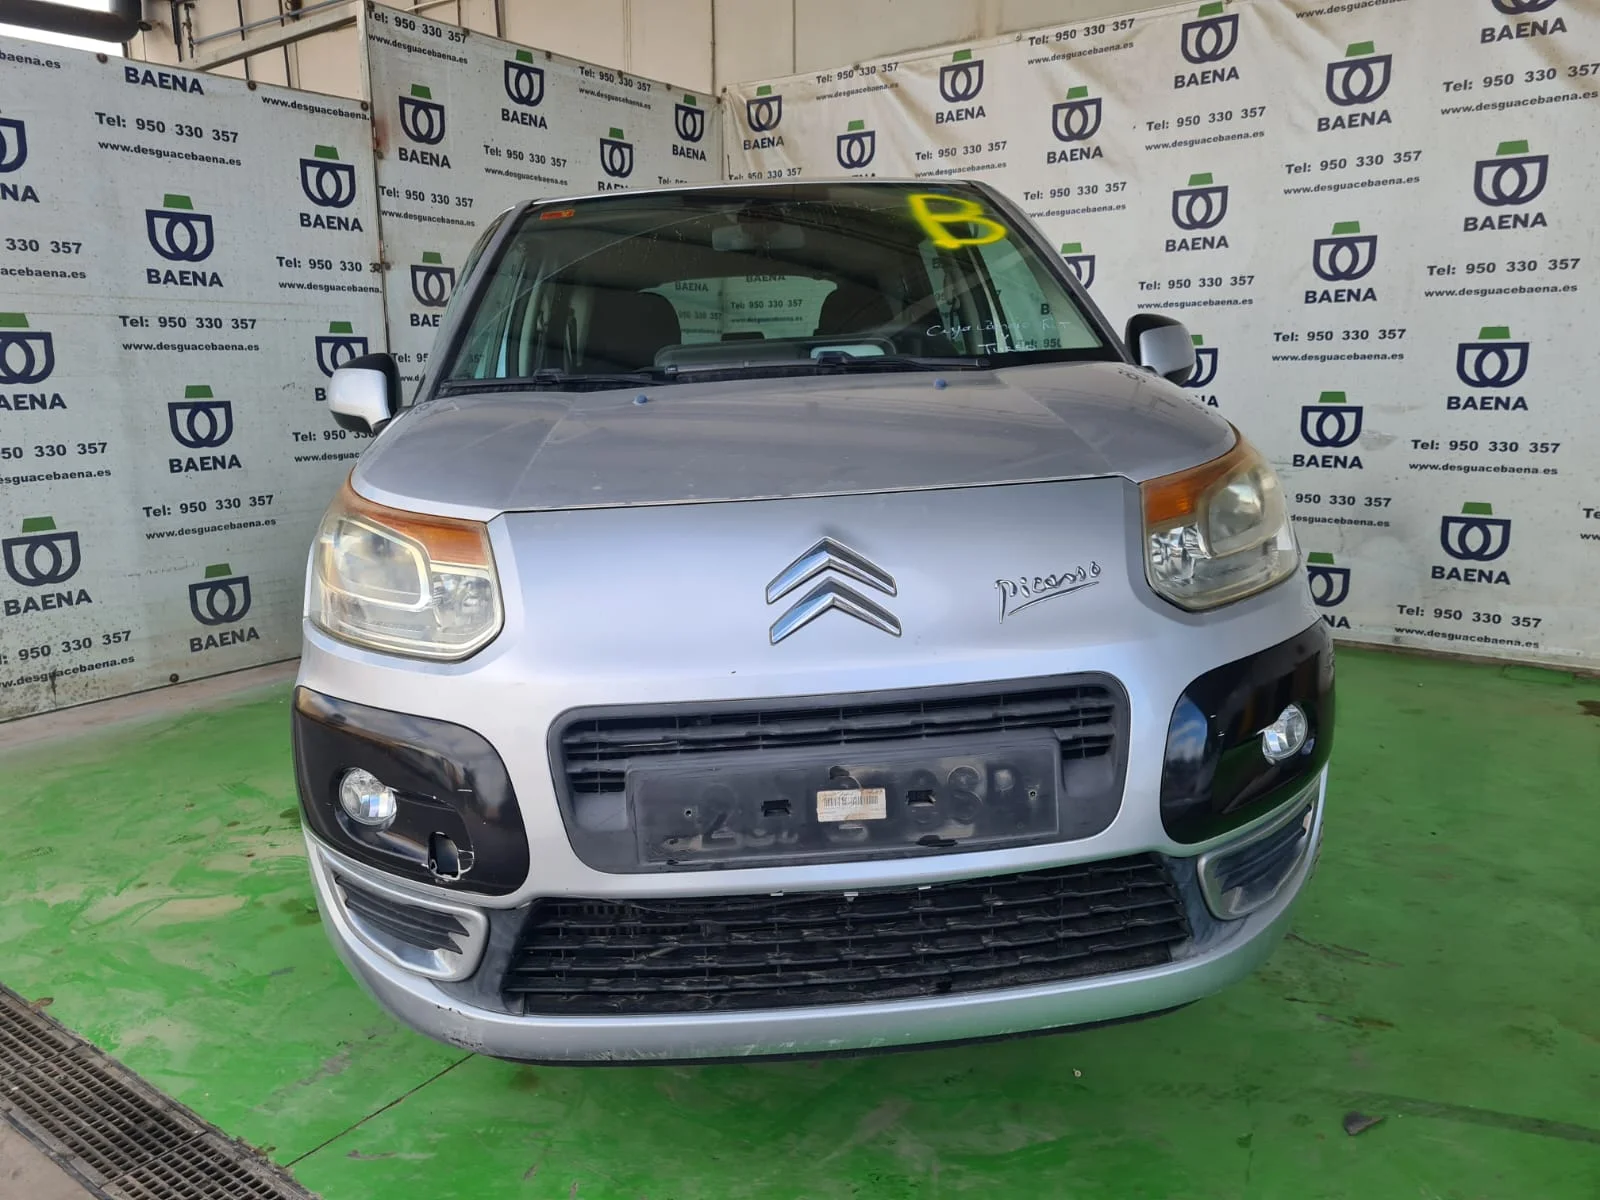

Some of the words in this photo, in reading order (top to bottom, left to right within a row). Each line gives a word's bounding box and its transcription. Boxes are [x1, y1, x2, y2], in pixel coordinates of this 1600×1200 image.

[366, 10, 388, 24] Tel:
[394, 16, 415, 31] 950
[422, 24, 441, 37] 330
[448, 30, 467, 44] 357
[1028, 35, 1049, 46] Tel:
[1055, 29, 1076, 42] 950
[1084, 24, 1105, 36] 330
[1112, 18, 1135, 31] 357
[1481, 18, 1567, 44] BAENA
[368, 33, 468, 65] www.desguacebaena.es
[1028, 42, 1133, 64] www.desguacebaena.es
[124, 66, 204, 95] BAENA
[578, 66, 595, 78] Tel:
[599, 71, 614, 83] 950
[619, 76, 633, 88] 330
[637, 81, 651, 92] 357
[816, 74, 832, 84] Tel:
[837, 70, 854, 81] 950
[859, 66, 877, 77] 330
[881, 62, 899, 73] 357
[1174, 67, 1239, 89] BAENA
[1443, 80, 1472, 92] Tel:
[1483, 74, 1514, 88] 950
[1525, 68, 1557, 82] 330
[1568, 63, 1600, 77] 357
[579, 88, 651, 110] www.desguacebaena.es
[816, 82, 899, 101] www.desguacebaena.es
[1441, 91, 1598, 115] www.desguacebaena.es
[502, 108, 547, 129] BAENA
[936, 106, 986, 124] BAENA
[1146, 120, 1168, 131] Tel:
[1177, 115, 1200, 127] 950
[1209, 111, 1232, 123] 330
[1241, 106, 1266, 118] 357
[1318, 110, 1392, 132] BAENA
[95, 112, 126, 128] Tel:
[136, 118, 165, 133] 950
[175, 124, 203, 138] 330
[212, 129, 238, 143] 357
[744, 136, 784, 150] BAENA
[1145, 131, 1264, 150] www.desguacebaena.es
[98, 142, 241, 166] www.desguacebaena.es
[399, 147, 451, 168] BAENA
[484, 145, 501, 156] Tel:
[507, 149, 524, 160] 950
[529, 153, 546, 164] 330
[551, 157, 567, 167] 357
[673, 144, 706, 161] BAENA
[915, 151, 932, 160] Tel:
[938, 148, 956, 157] 950
[963, 144, 981, 155] 330
[988, 141, 1007, 151] 357
[1047, 146, 1103, 164] BAENA
[787, 167, 802, 176] 357
[915, 162, 1007, 178] www.desguacebaena.es
[1285, 163, 1311, 174] Tel:
[1320, 159, 1346, 171] 950
[1356, 155, 1384, 167] 330
[1393, 150, 1422, 163] 357
[484, 168, 568, 185] www.desguacebaena.es
[1284, 177, 1420, 194] www.desguacebaena.es
[379, 186, 400, 198] Tel:
[405, 190, 424, 201] 950
[431, 193, 449, 205] 330
[456, 197, 473, 208] 357
[1024, 191, 1043, 200] Tel:
[1050, 188, 1070, 198] 950
[1078, 185, 1098, 195] 330
[1105, 182, 1126, 192] 357
[300, 213, 363, 232] BAENA
[381, 208, 475, 228] www.desguacebaena.es
[1464, 212, 1547, 232] BAENA
[6, 238, 39, 252] 330
[50, 241, 82, 254] 357
[1166, 236, 1228, 252] BAENA
[276, 256, 301, 268] Tel:
[309, 259, 332, 270] 950
[340, 261, 362, 272] 330
[1427, 265, 1456, 276] Tel:
[1466, 263, 1496, 274] 950
[1506, 260, 1537, 272] 330
[1548, 258, 1580, 270] 357
[147, 268, 223, 287] BAENA
[1139, 281, 1160, 290] Tel:
[1168, 279, 1191, 289] 950
[1199, 277, 1222, 287] 330
[1230, 276, 1254, 286] 357
[1305, 288, 1377, 304] BAENA
[1425, 285, 1577, 297] www.desguacebaena.es
[1138, 299, 1253, 309] www.desguacebaena.es
[119, 315, 149, 327] Tel:
[158, 317, 186, 328] 950
[196, 317, 222, 328] 330
[231, 319, 256, 329] 357
[410, 314, 440, 327] BAE
[1274, 332, 1298, 342] Tel:
[1307, 331, 1333, 341] 950
[1342, 330, 1369, 340] 330
[1378, 329, 1406, 339] 357
[122, 342, 259, 352] www.desguacebaena.es
[1272, 353, 1404, 362] www.desguacebaena.es
[1447, 396, 1528, 410] BAENA
[292, 432, 316, 442] Tel:
[324, 430, 346, 440] 950
[34, 444, 66, 457] 330
[77, 442, 107, 455] 357
[1411, 440, 1439, 450] Tel:
[1449, 441, 1478, 451] 950
[1488, 441, 1518, 452] 330
[1529, 443, 1560, 453] 357
[169, 455, 242, 473] BAENA
[1293, 455, 1363, 469] BAENA
[1409, 463, 1558, 475] www.desguacebaena.es
[142, 505, 171, 517] Tel:
[180, 501, 206, 513] 950
[216, 498, 241, 510] 330
[249, 495, 273, 507] 357
[1296, 494, 1321, 504] 950
[1329, 495, 1355, 505] 330
[1364, 497, 1391, 507] 357
[146, 519, 276, 539] www.desguacebaena.es
[1431, 566, 1510, 585] BAENA
[4, 589, 92, 616] BAENA
[1397, 605, 1424, 616] Tel:
[1434, 608, 1462, 620] 950
[1472, 612, 1501, 624] 330
[1511, 616, 1542, 628] 357
[19, 645, 51, 660] 950
[62, 638, 92, 652] 330
[102, 630, 131, 645] 357
[190, 627, 260, 652] BAENA
[1395, 626, 1540, 649] www.desguacebaena.es
